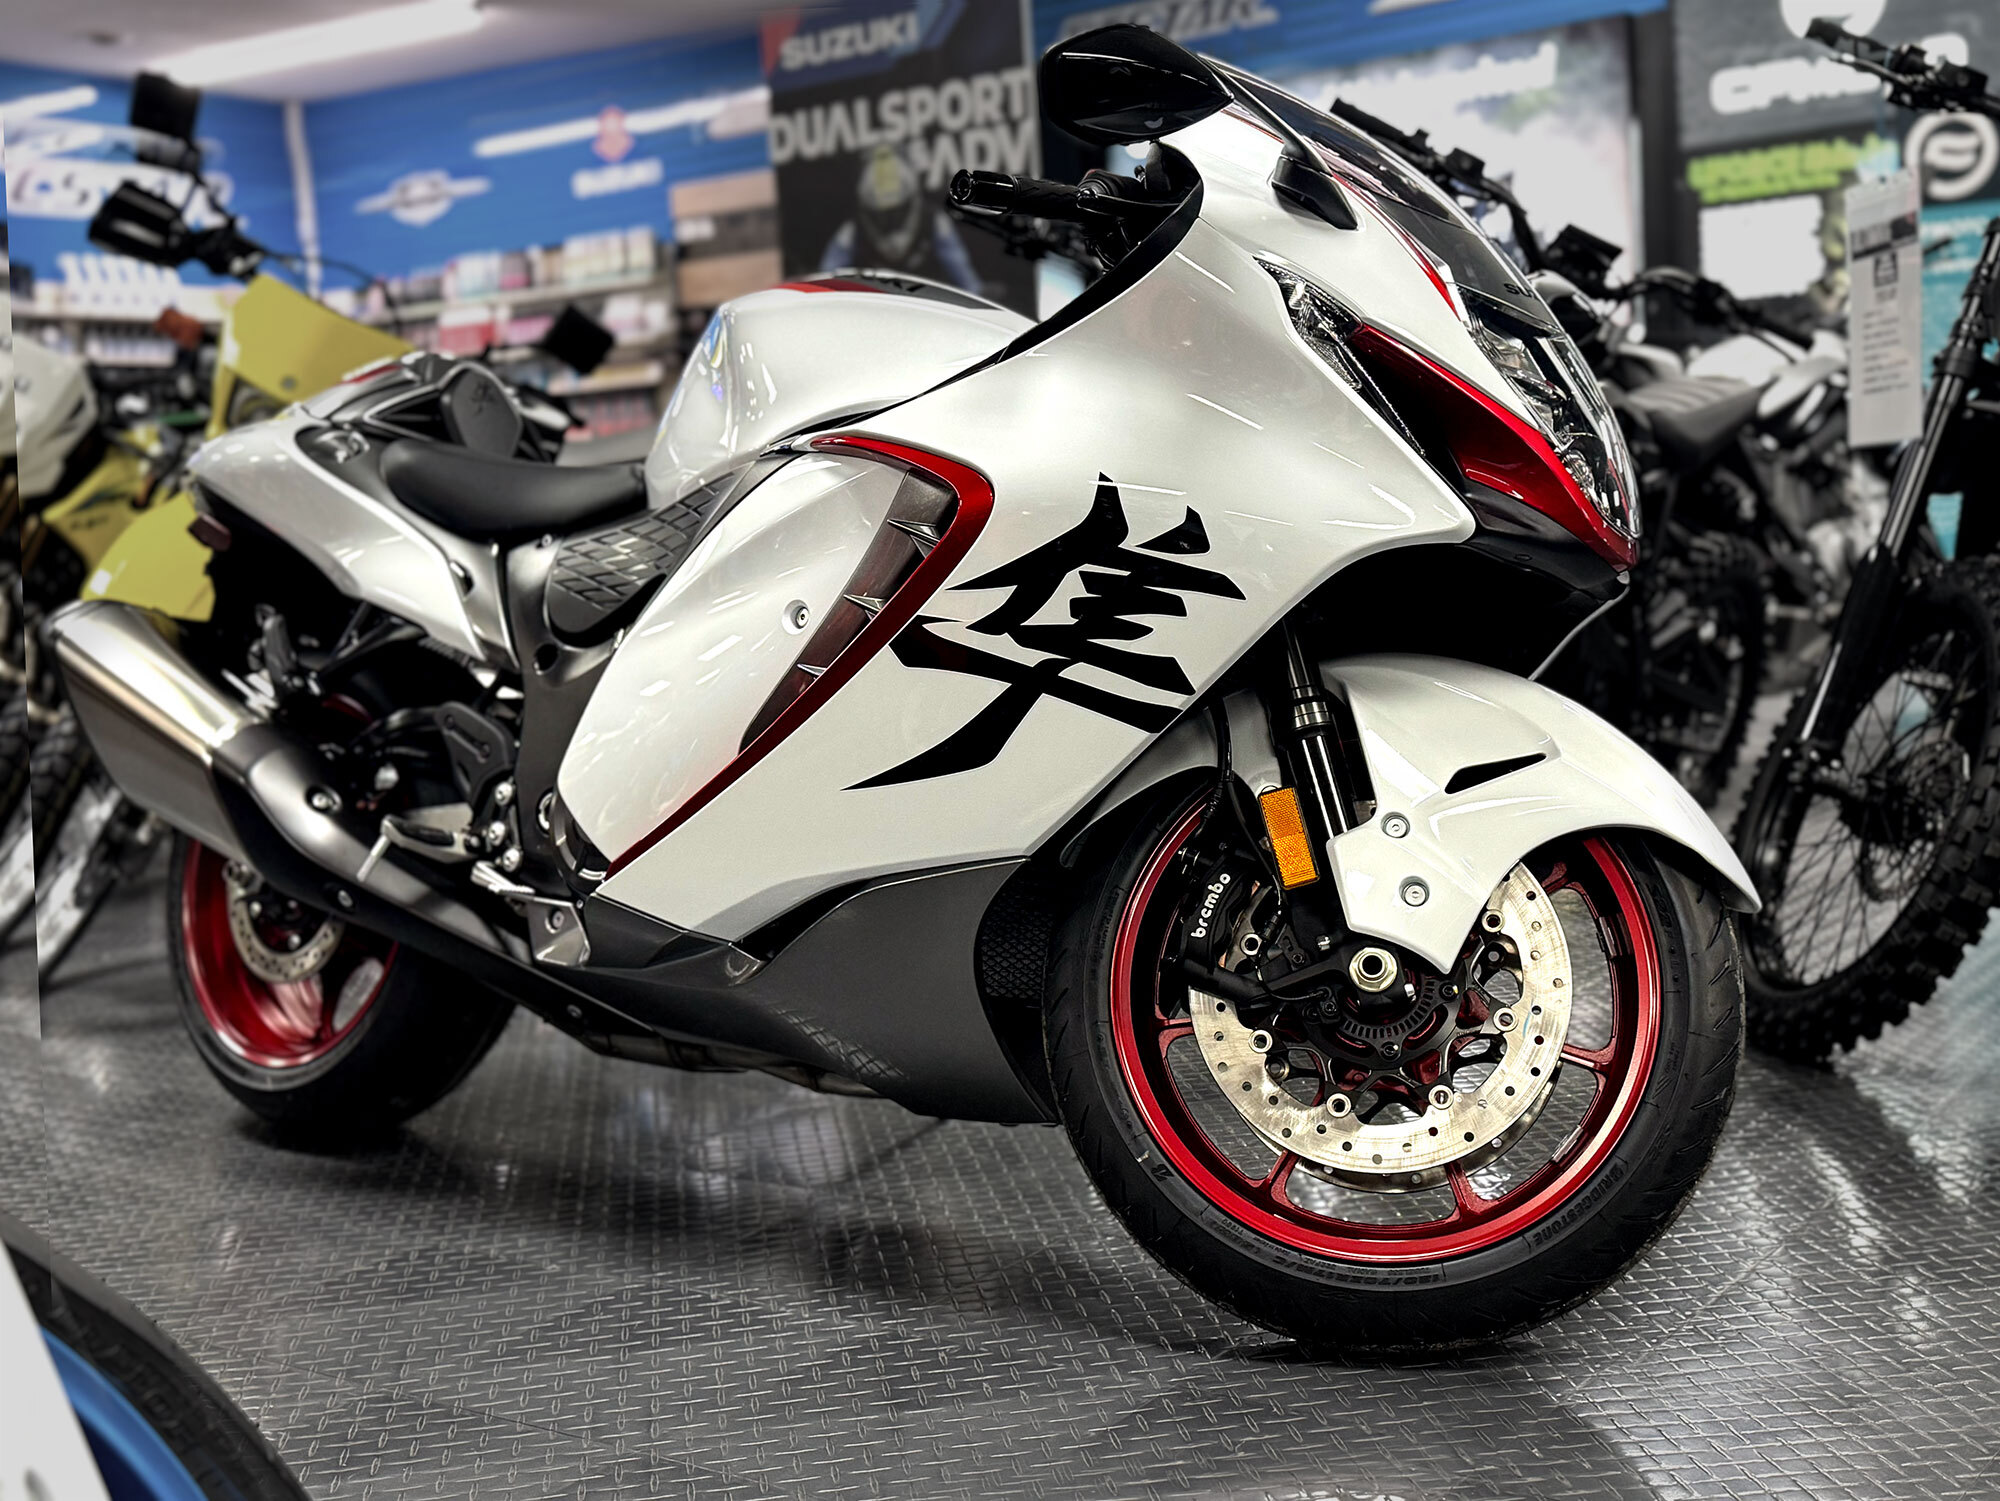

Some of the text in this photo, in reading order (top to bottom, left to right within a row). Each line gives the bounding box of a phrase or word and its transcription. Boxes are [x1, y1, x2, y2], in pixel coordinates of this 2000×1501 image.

[779, 11, 921, 70] SUZUKI
[769, 67, 1031, 164] DUALSPORT
[841, 472, 1248, 790] 隼
[1190, 873, 1231, 938] brembo
[1532, 1163, 1625, 1247] BRIDGESTONE
